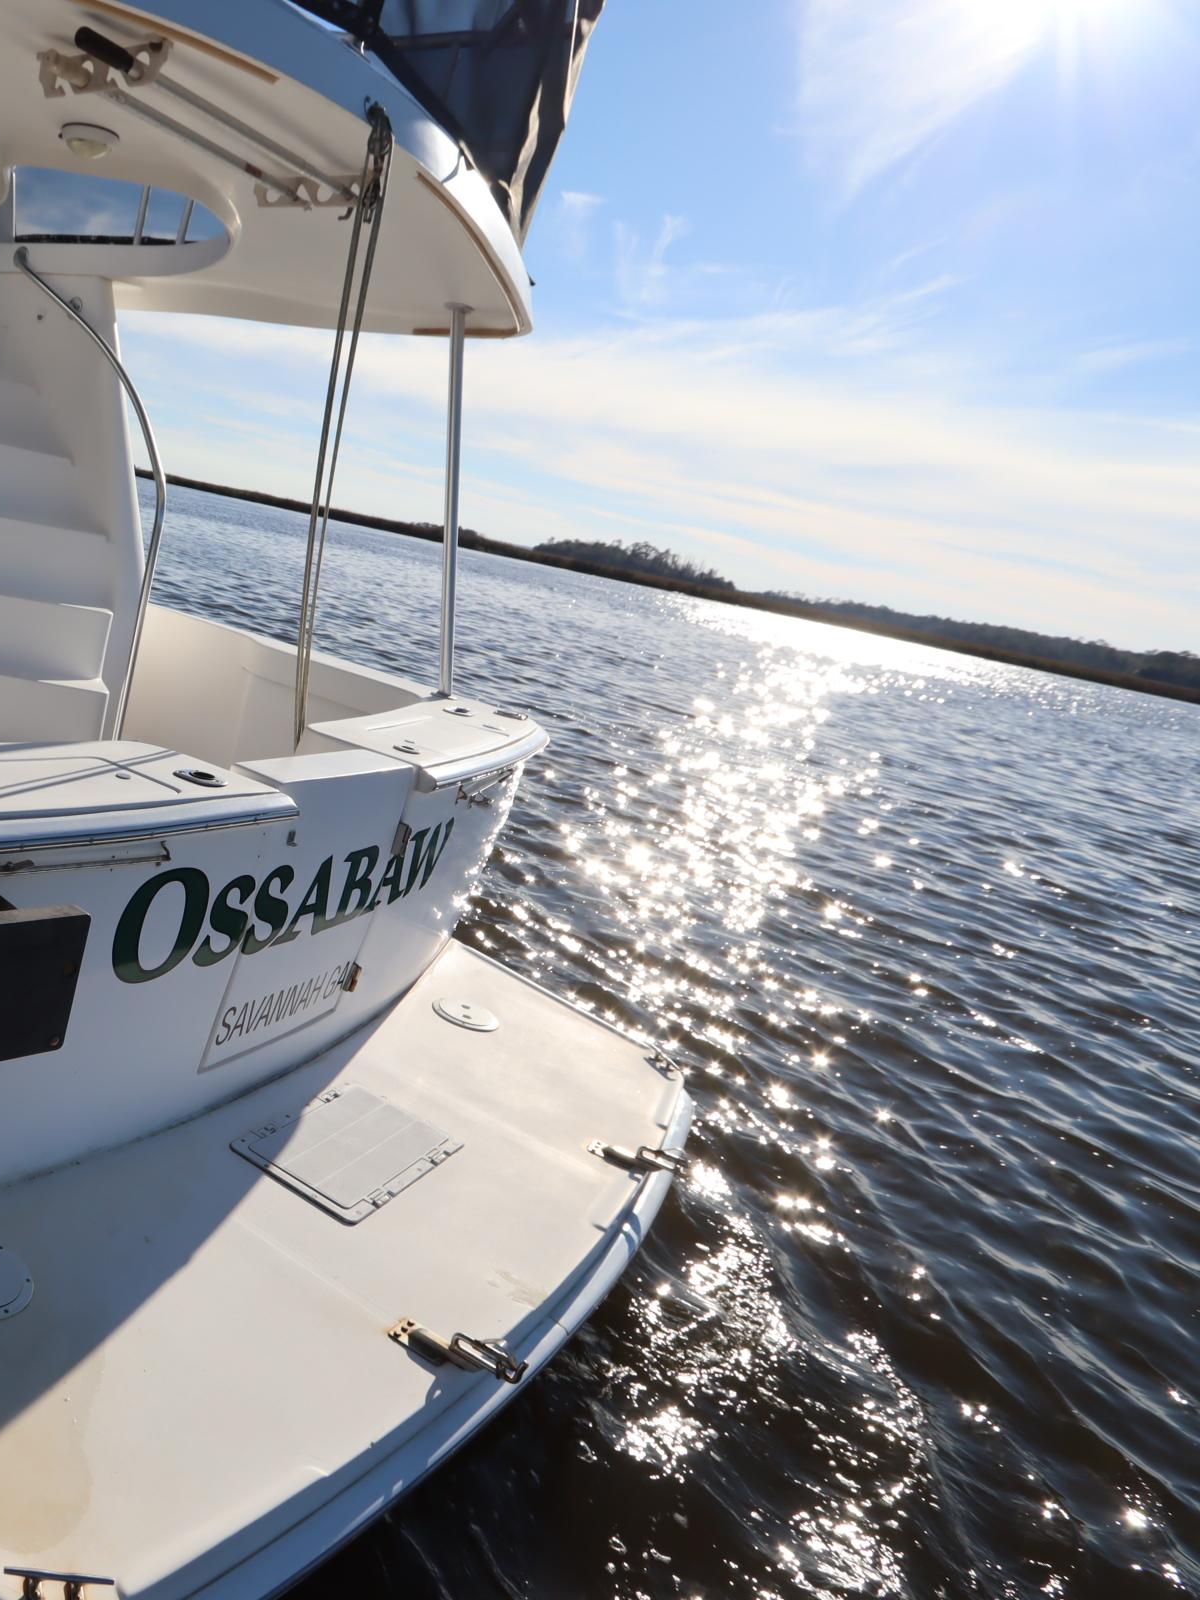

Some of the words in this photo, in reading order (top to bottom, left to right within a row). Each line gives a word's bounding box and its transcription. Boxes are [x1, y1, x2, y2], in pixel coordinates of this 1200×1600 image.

[112, 817, 455, 984] OSSABAW
[215, 972, 329, 1046] SAVANNAH
[323, 960, 351, 1000] GA
